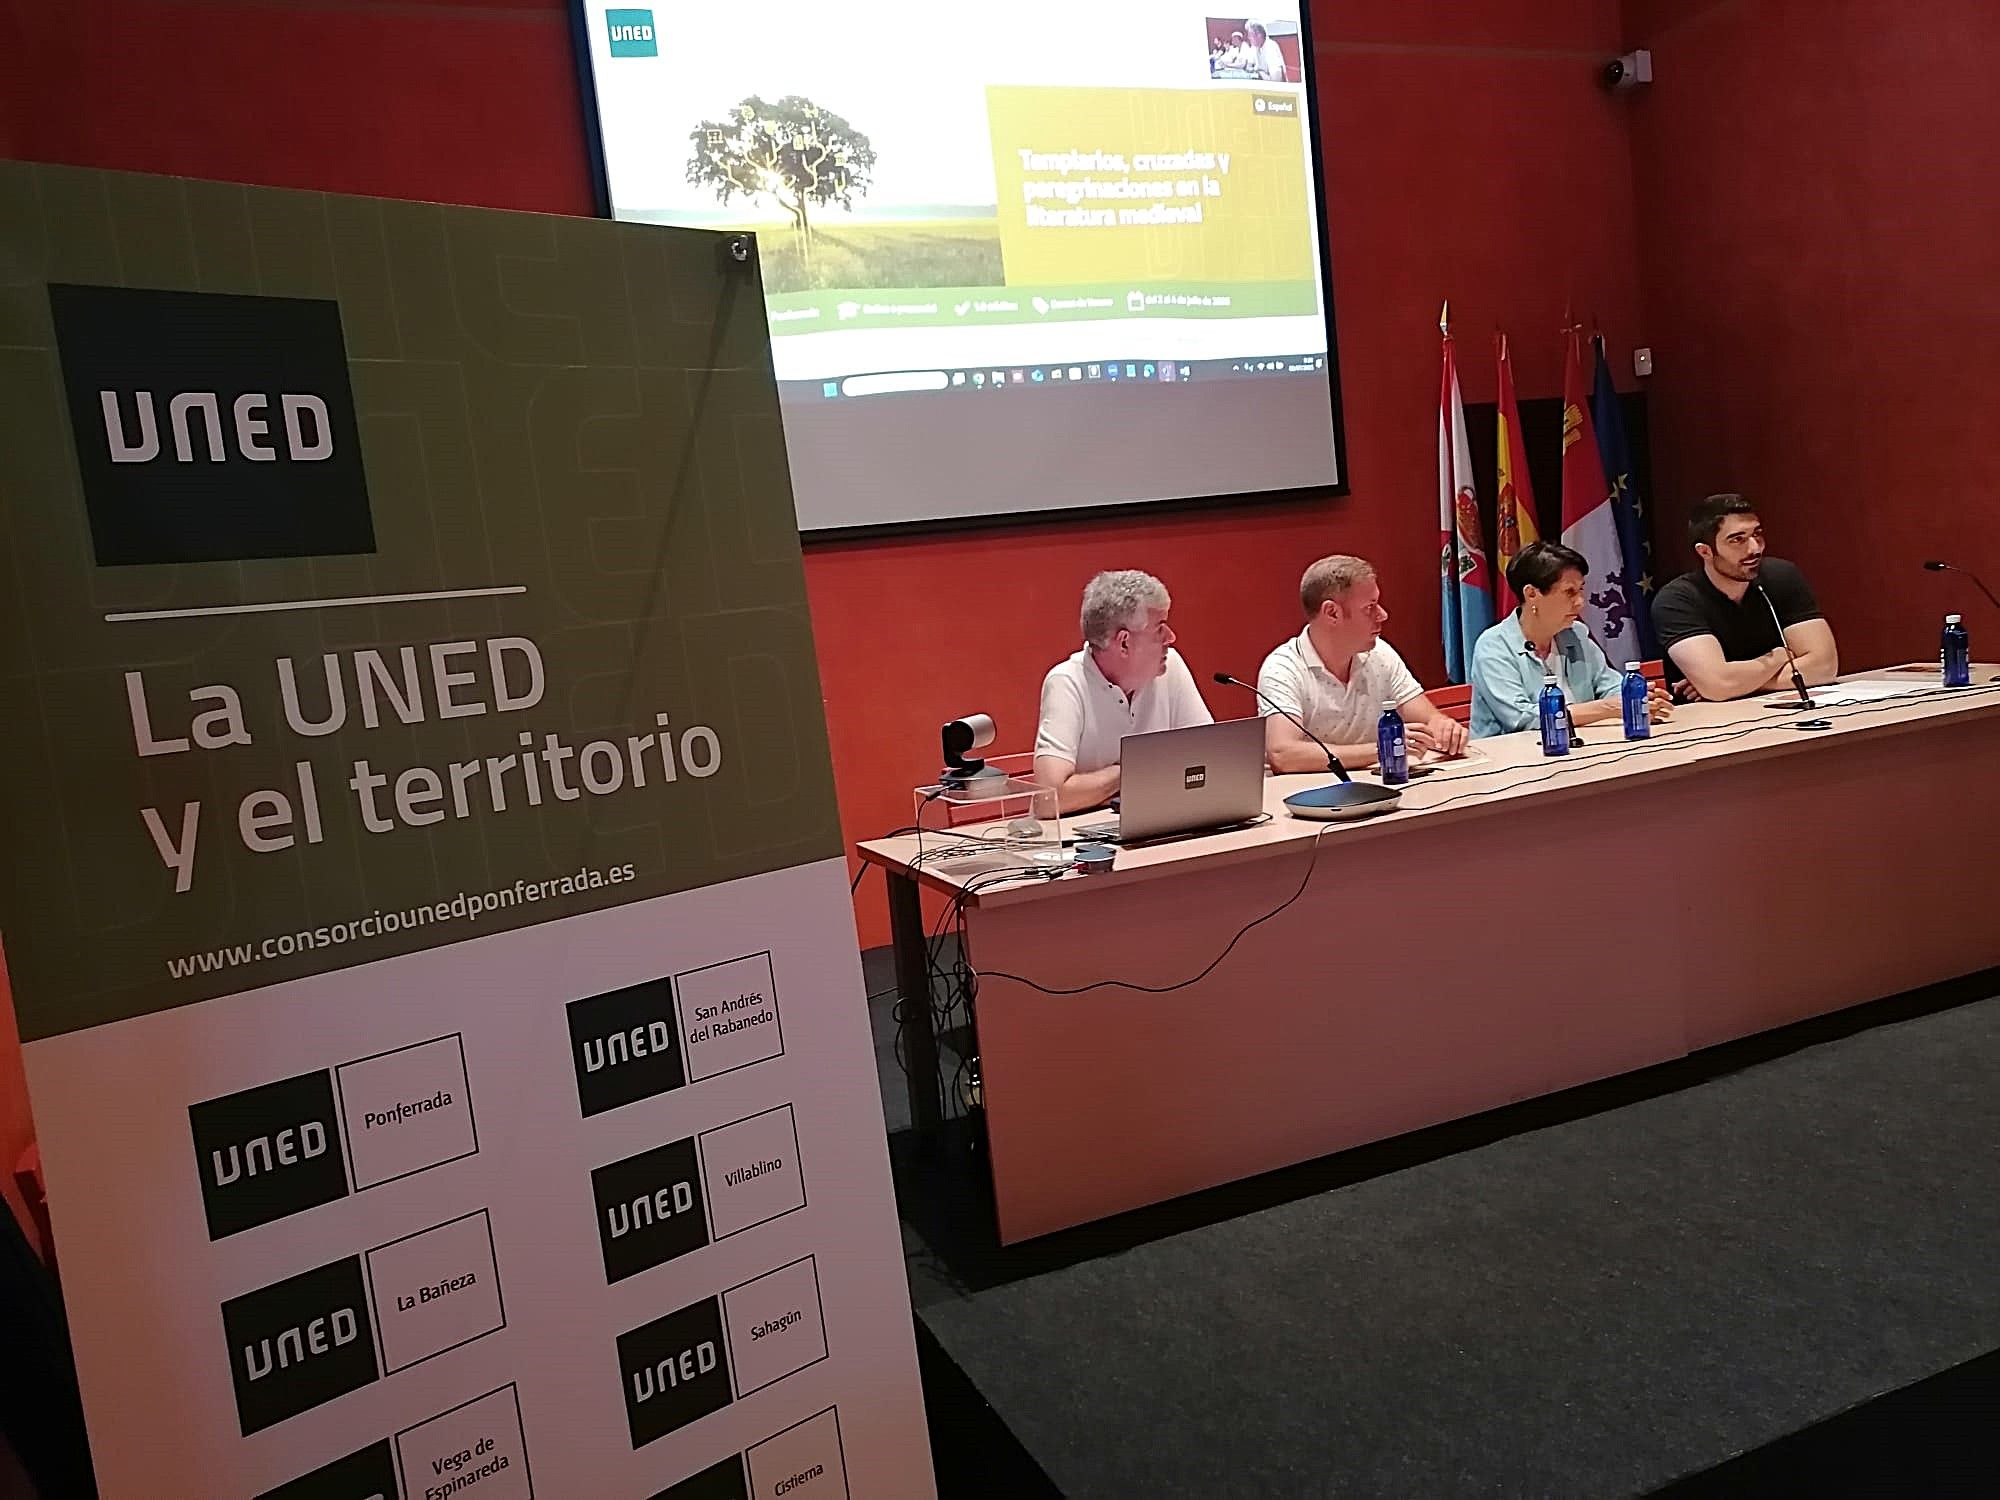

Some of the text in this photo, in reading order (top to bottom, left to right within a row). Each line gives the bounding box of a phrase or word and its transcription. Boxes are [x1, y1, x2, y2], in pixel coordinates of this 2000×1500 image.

[611, 25, 653, 41] UNED
[1017, 149, 1230, 176] Templarios, cruzadas y
[1023, 175, 1220, 204] peregrinaciones en la
[1026, 202, 1202, 226] literatura medieval
[100, 390, 334, 463] UNED
[124, 635, 546, 757] La UNED
[140, 713, 722, 893] y el territorio
[167, 860, 636, 980] www.consorciounedponferrada.es
[695, 992, 763, 1021] San Andrés
[690, 1009, 773, 1044] del Rabanedo
[583, 1021, 669, 1073] UNED
[364, 1090, 453, 1129] Ponferrada
[212, 1121, 327, 1187] UNED
[724, 1157, 782, 1187] Villablino
[608, 1181, 693, 1239] UNED
[397, 1273, 477, 1312] La Bañeza
[244, 1307, 358, 1381] UNED
[750, 1309, 802, 1342] Sahagún
[633, 1341, 717, 1403] UNED
[432, 1438, 495, 1475] Vega de
[425, 1456, 510, 1500] Espinareda
[774, 1464, 824, 1497] Cistierna
